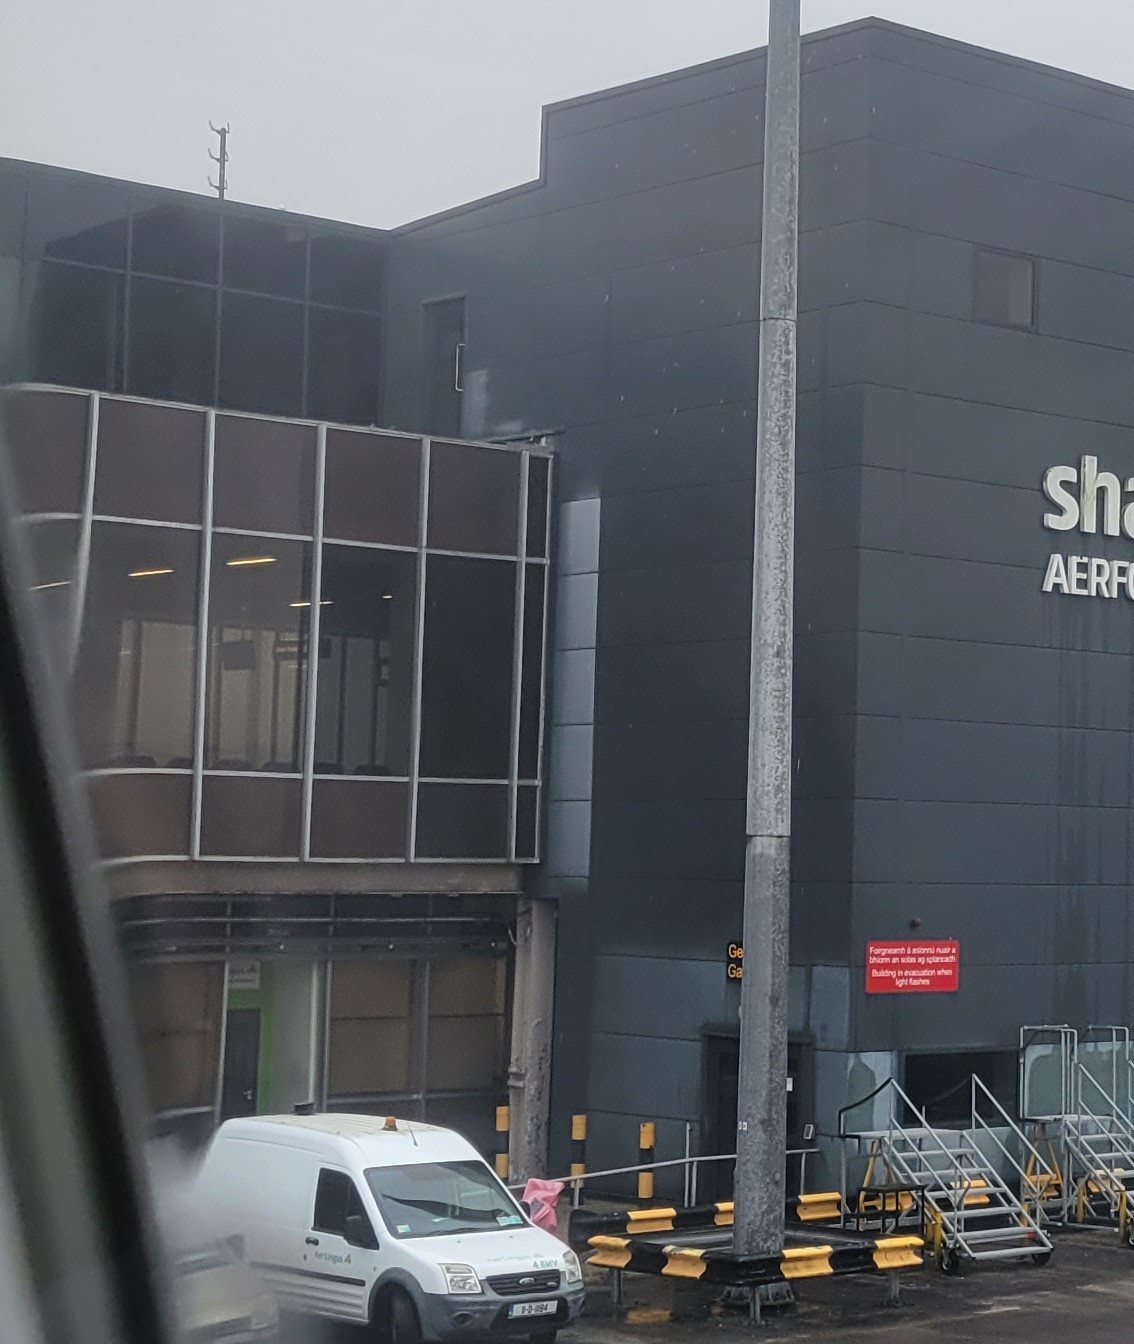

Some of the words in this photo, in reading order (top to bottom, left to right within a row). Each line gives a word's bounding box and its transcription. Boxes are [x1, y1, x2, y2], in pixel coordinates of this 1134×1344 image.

[869, 946, 905, 956] Foirgneamh
[872, 969, 896, 978] Building
[895, 978, 908, 988] light
